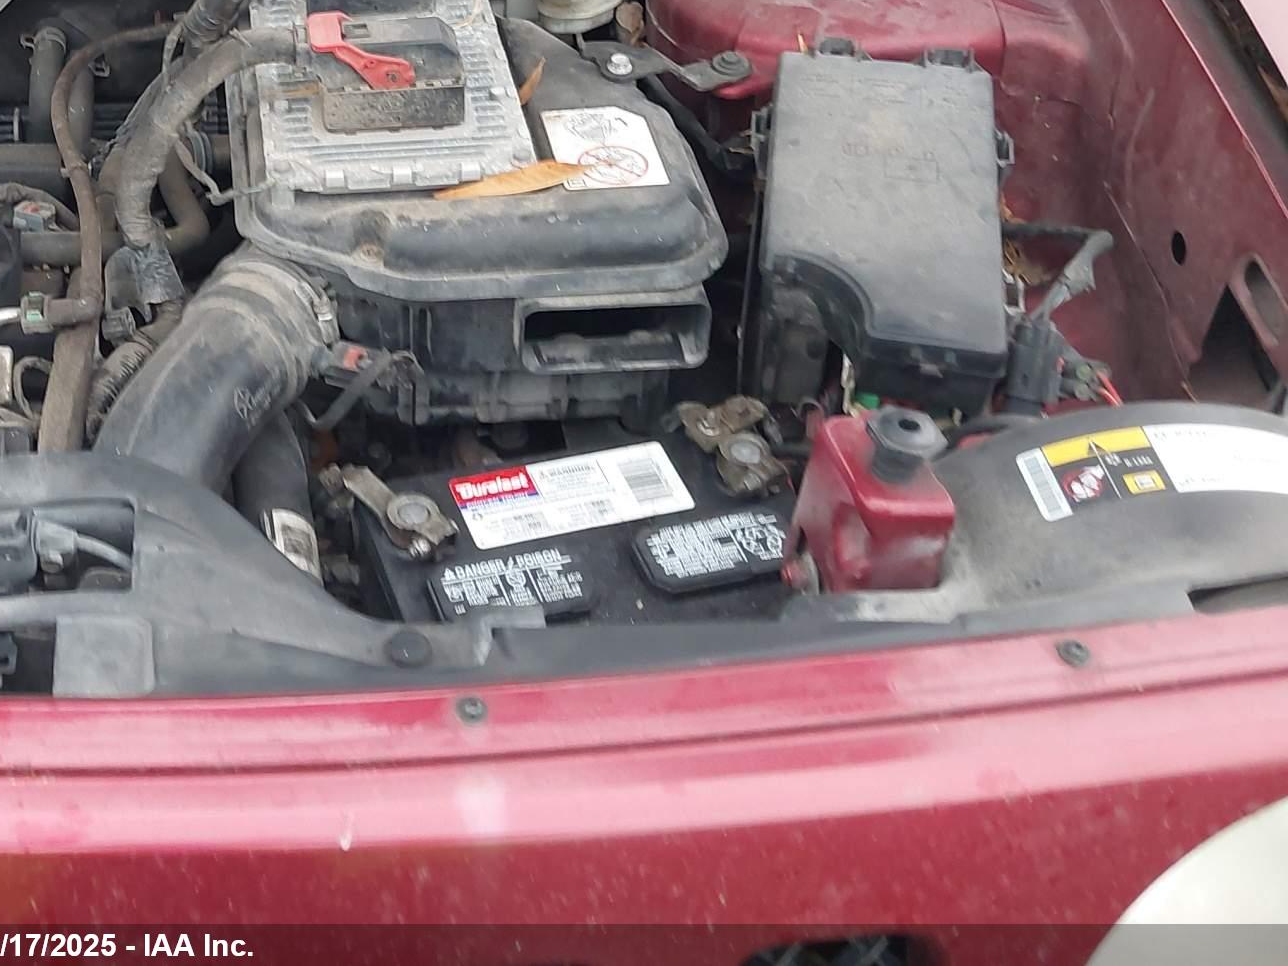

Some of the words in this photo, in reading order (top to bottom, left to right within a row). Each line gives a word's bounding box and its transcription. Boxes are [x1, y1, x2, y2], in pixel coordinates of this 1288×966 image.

[454, 471, 529, 500] Duralast
[454, 558, 506, 580] DANGER
[515, 548, 562, 568] POISON
